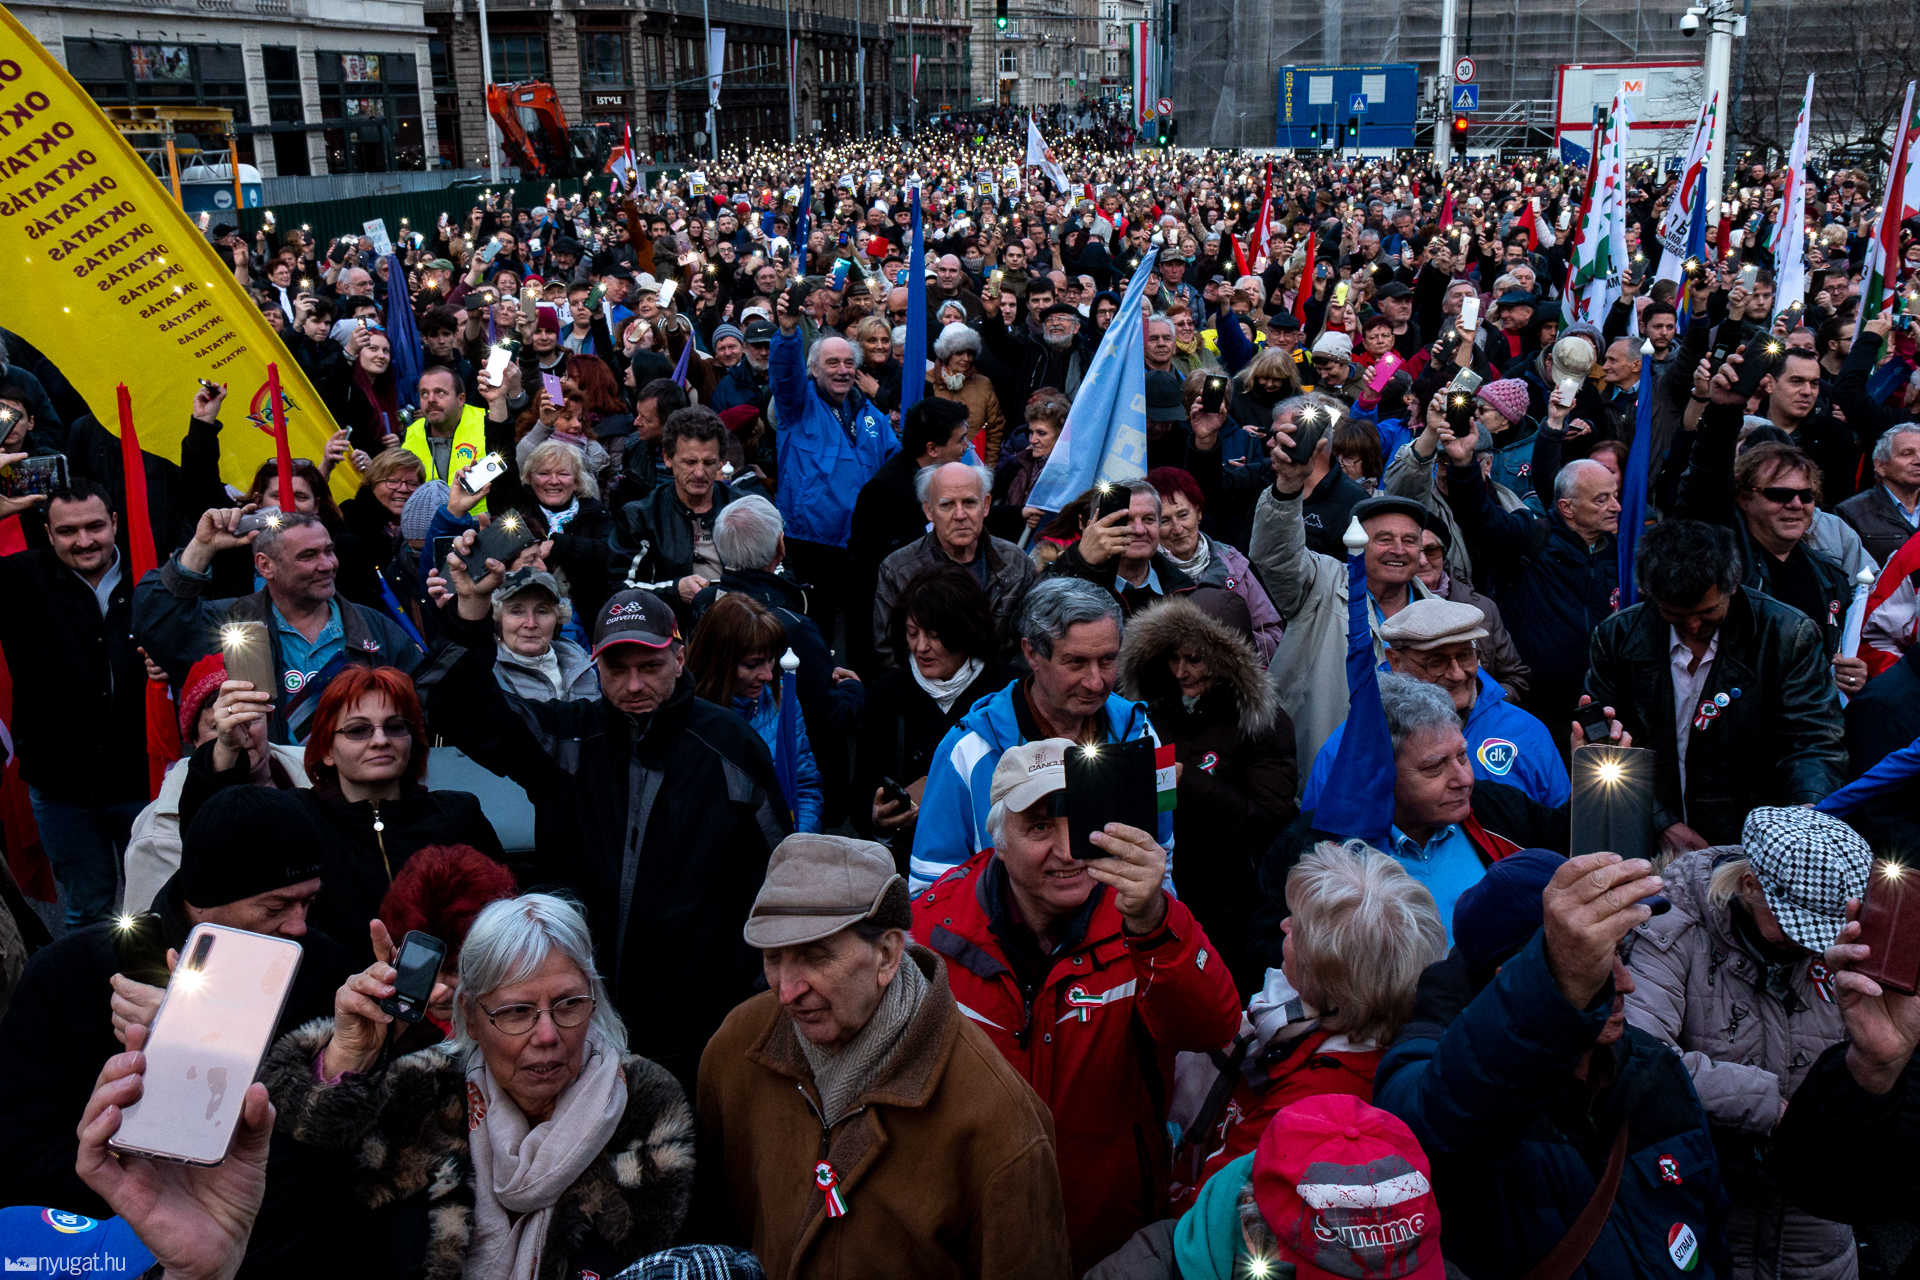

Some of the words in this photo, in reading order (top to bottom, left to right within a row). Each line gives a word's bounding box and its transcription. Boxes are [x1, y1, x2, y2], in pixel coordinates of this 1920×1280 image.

[1459, 65, 1470, 76] 30
[1490, 748, 1506, 761] dk
[1028, 760, 1064, 773] CANCU
